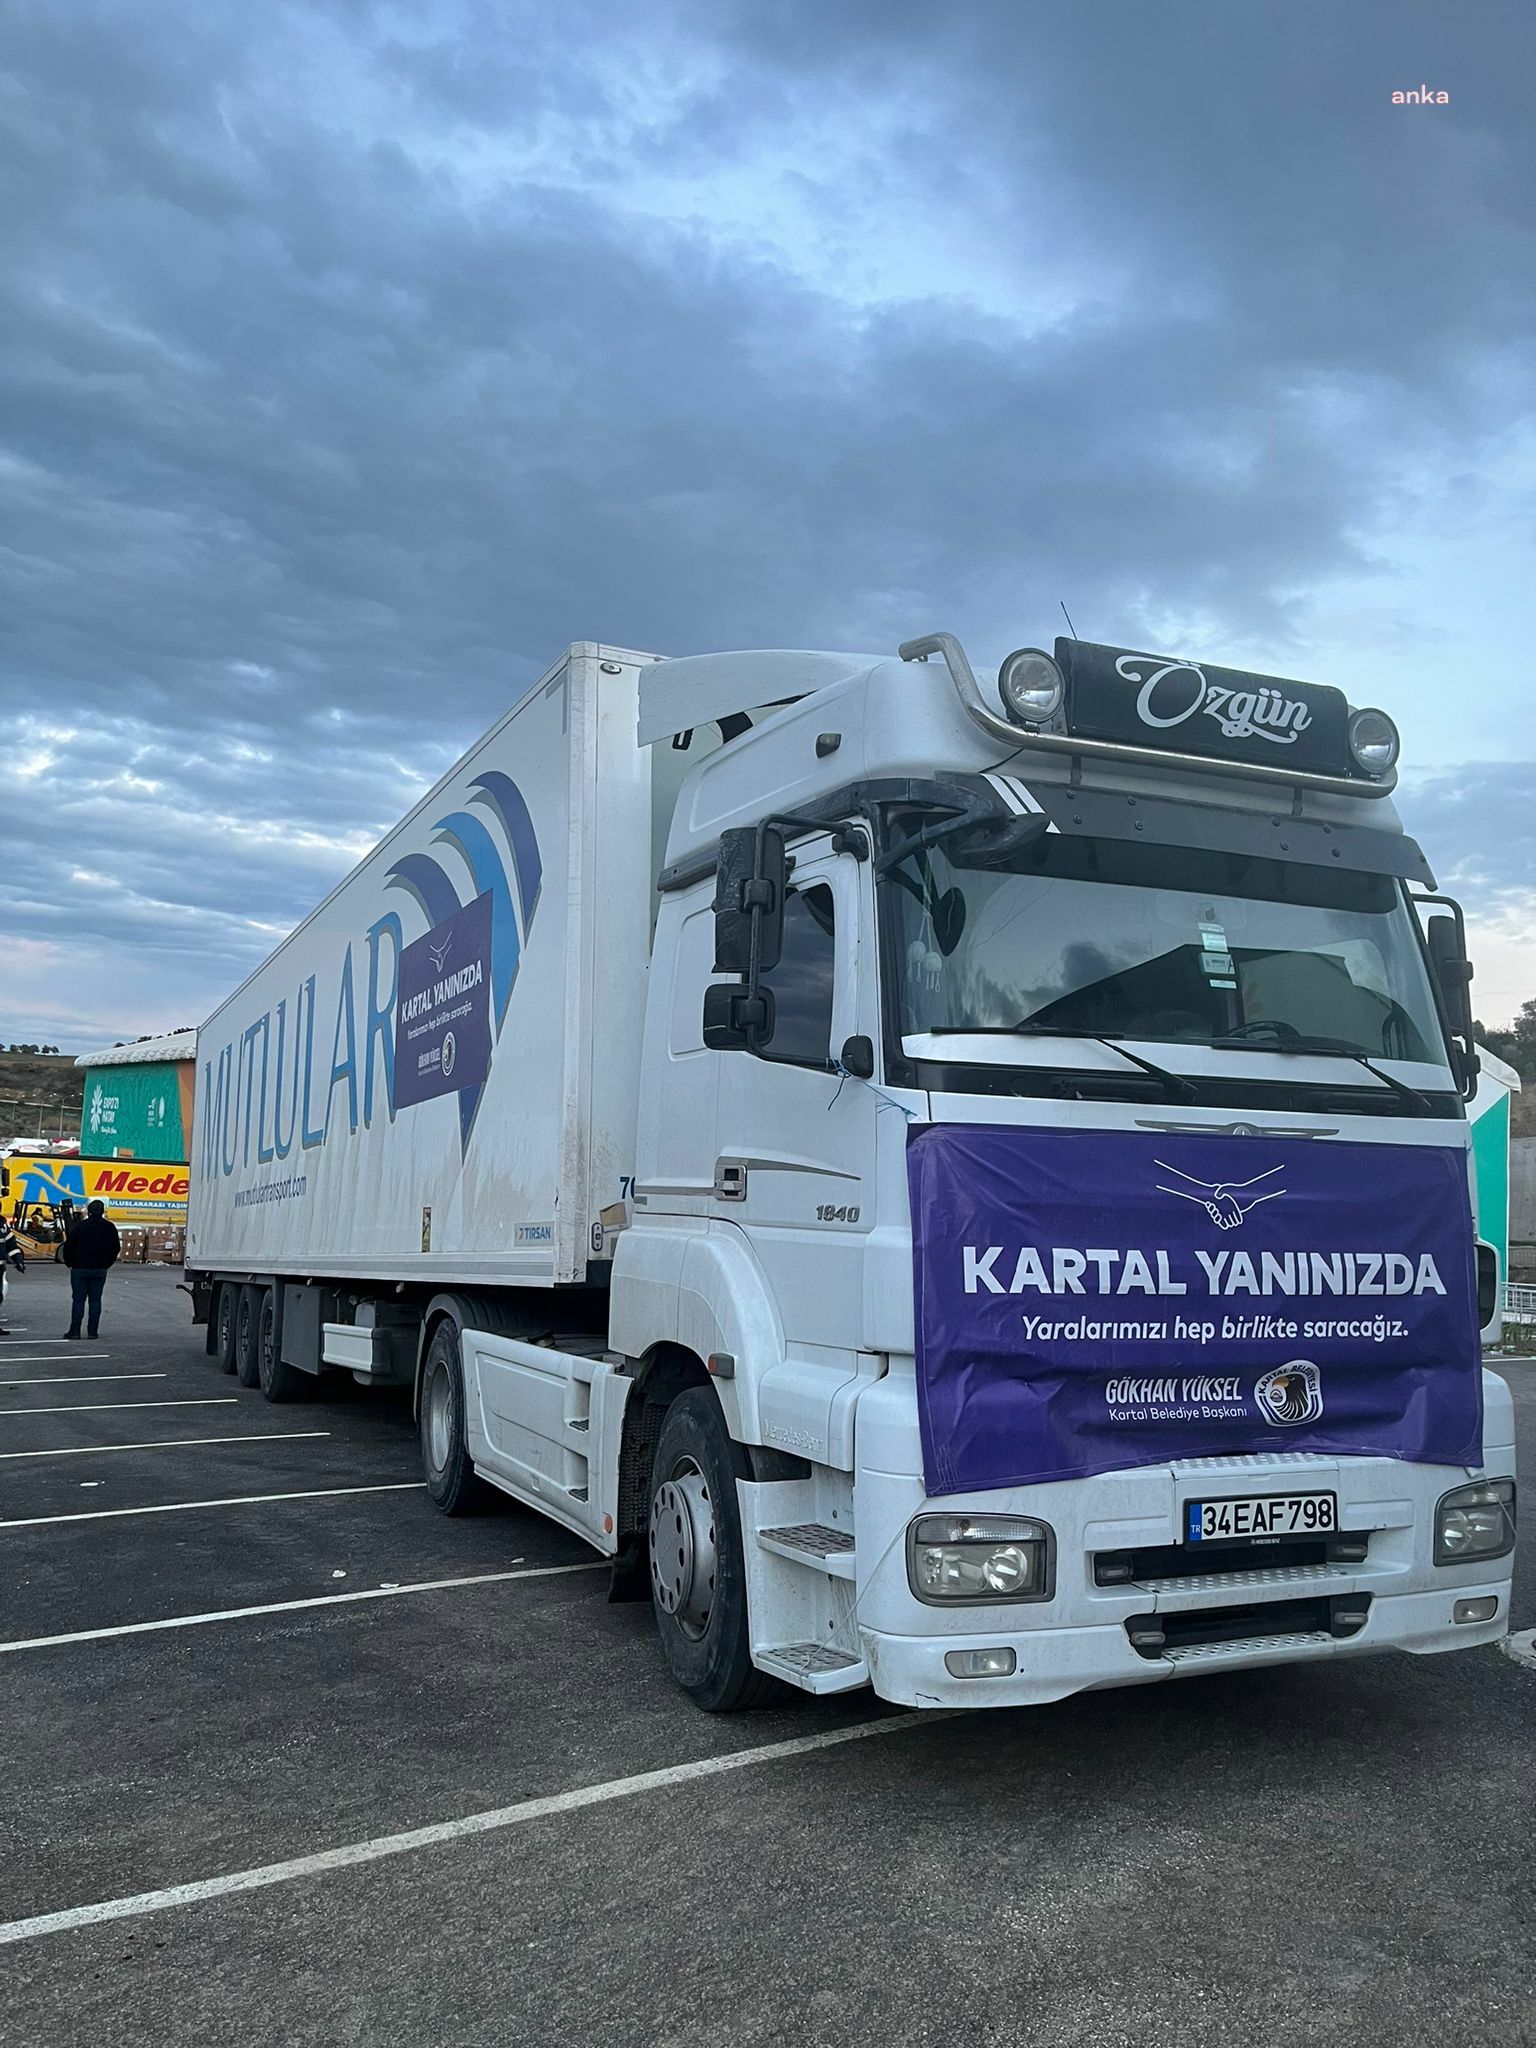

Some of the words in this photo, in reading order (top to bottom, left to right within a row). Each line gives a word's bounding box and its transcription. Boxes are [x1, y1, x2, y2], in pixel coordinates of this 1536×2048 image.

[1115, 655, 1312, 744] Özgün
[401, 988, 432, 1024] KARTAL
[434, 959, 482, 1006] YANINIZDA
[201, 911, 403, 1182] MUTLULAR
[94, 1170, 189, 1195] Mede
[816, 1204, 861, 1223] 1840
[525, 1227, 551, 1240] TIRSAN
[963, 1246, 1187, 1295] KARTAL
[1194, 1250, 1448, 1296] YANINIZDA
[1022, 1315, 1166, 1340] Yaralarımızı
[1174, 1315, 1216, 1344] hep
[1221, 1315, 1297, 1339] birlikte
[1303, 1314, 1409, 1342] saracağız.
[1105, 1376, 1178, 1404] GÖKHAN
[1182, 1375, 1242, 1401] YÜKSEL
[1258, 1368, 1288, 1394] KARTAL
[1109, 1407, 1148, 1421] Kartal
[1150, 1406, 1199, 1421] Belediye
[1202, 1405, 1248, 1420] Başkanı
[1191, 1524, 1201, 1533] TR
